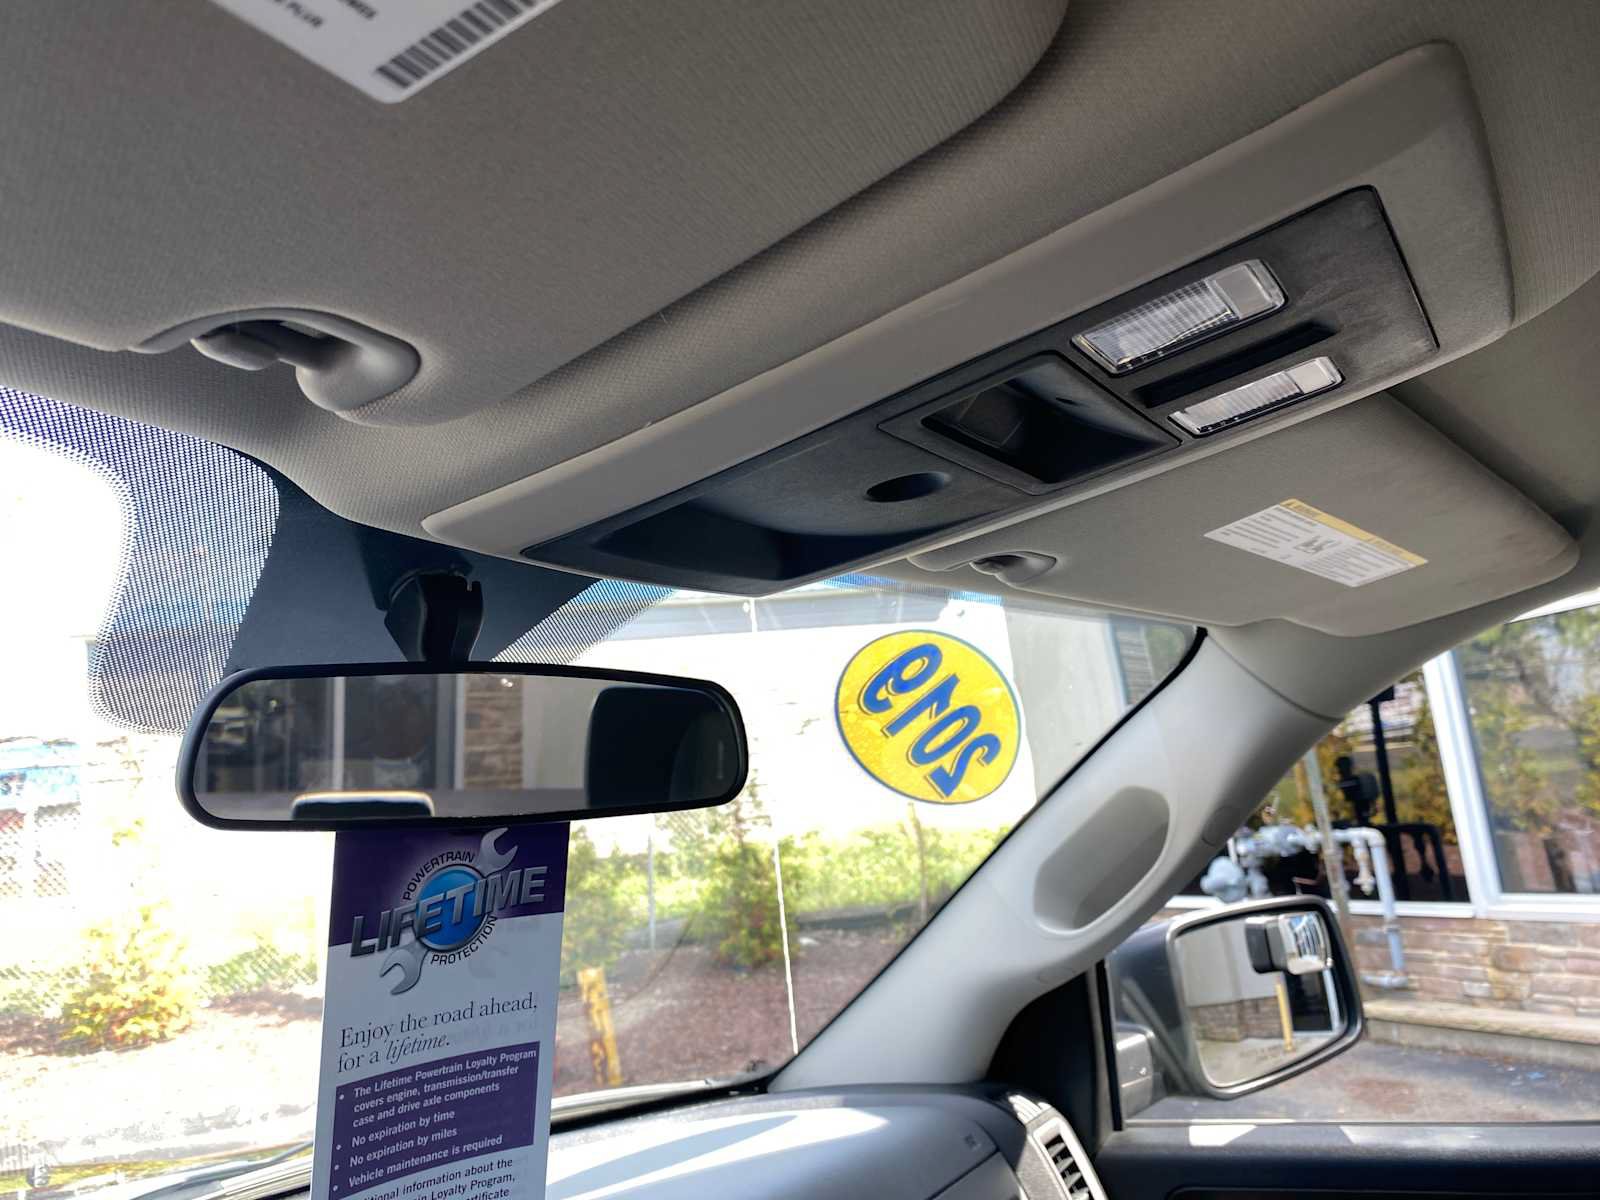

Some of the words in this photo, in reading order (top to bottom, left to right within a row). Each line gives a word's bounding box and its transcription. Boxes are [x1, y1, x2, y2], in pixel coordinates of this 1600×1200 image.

[403, 851, 475, 901] POWERTRAIN
[351, 866, 548, 957] LIFETIME
[431, 916, 498, 965] PROTECTION
[339, 1022, 394, 1049] Enjoy
[400, 1013, 427, 1033] the
[433, 1000, 474, 1026] road
[479, 991, 538, 1017] ahead,
[338, 1052, 365, 1073] for
[369, 1050, 379, 1064] a
[386, 1033, 450, 1064] lifetime.
[354, 1086, 371, 1098] The
[374, 1075, 413, 1092] Lifetime
[415, 1062, 463, 1081] Powertrain
[465, 1055, 498, 1070] Loyalty
[500, 1050, 537, 1063] Program
[353, 1114, 375, 1128] case
[377, 1106, 395, 1120] and
[398, 1101, 420, 1114] drive
[423, 1095, 442, 1107] axle
[444, 1082, 500, 1101] components
[354, 1097, 384, 1112] covers
[387, 1087, 420, 1103] engine,
[423, 1065, 519, 1093] transmission/transfer
[350, 1155, 364, 1167] No
[367, 1139, 414, 1160] expiration
[417, 1135, 429, 1147] by
[431, 1128, 458, 1142] miles
[352, 1136, 366, 1148] No
[369, 1120, 416, 1141] expiration
[419, 1116, 431, 1127] by
[433, 1110, 456, 1123] time
[348, 1167, 385, 1188] Vehicle
[386, 1149, 449, 1175] maintenance
[451, 1145, 460, 1156] is
[462, 1134, 503, 1153] required
[402, 1170, 461, 1195] information
[464, 1161, 493, 1177] about
[497, 1159, 513, 1169] the
[431, 1183, 467, 1200] Loyalty
[470, 1174, 515, 1191] Program,
